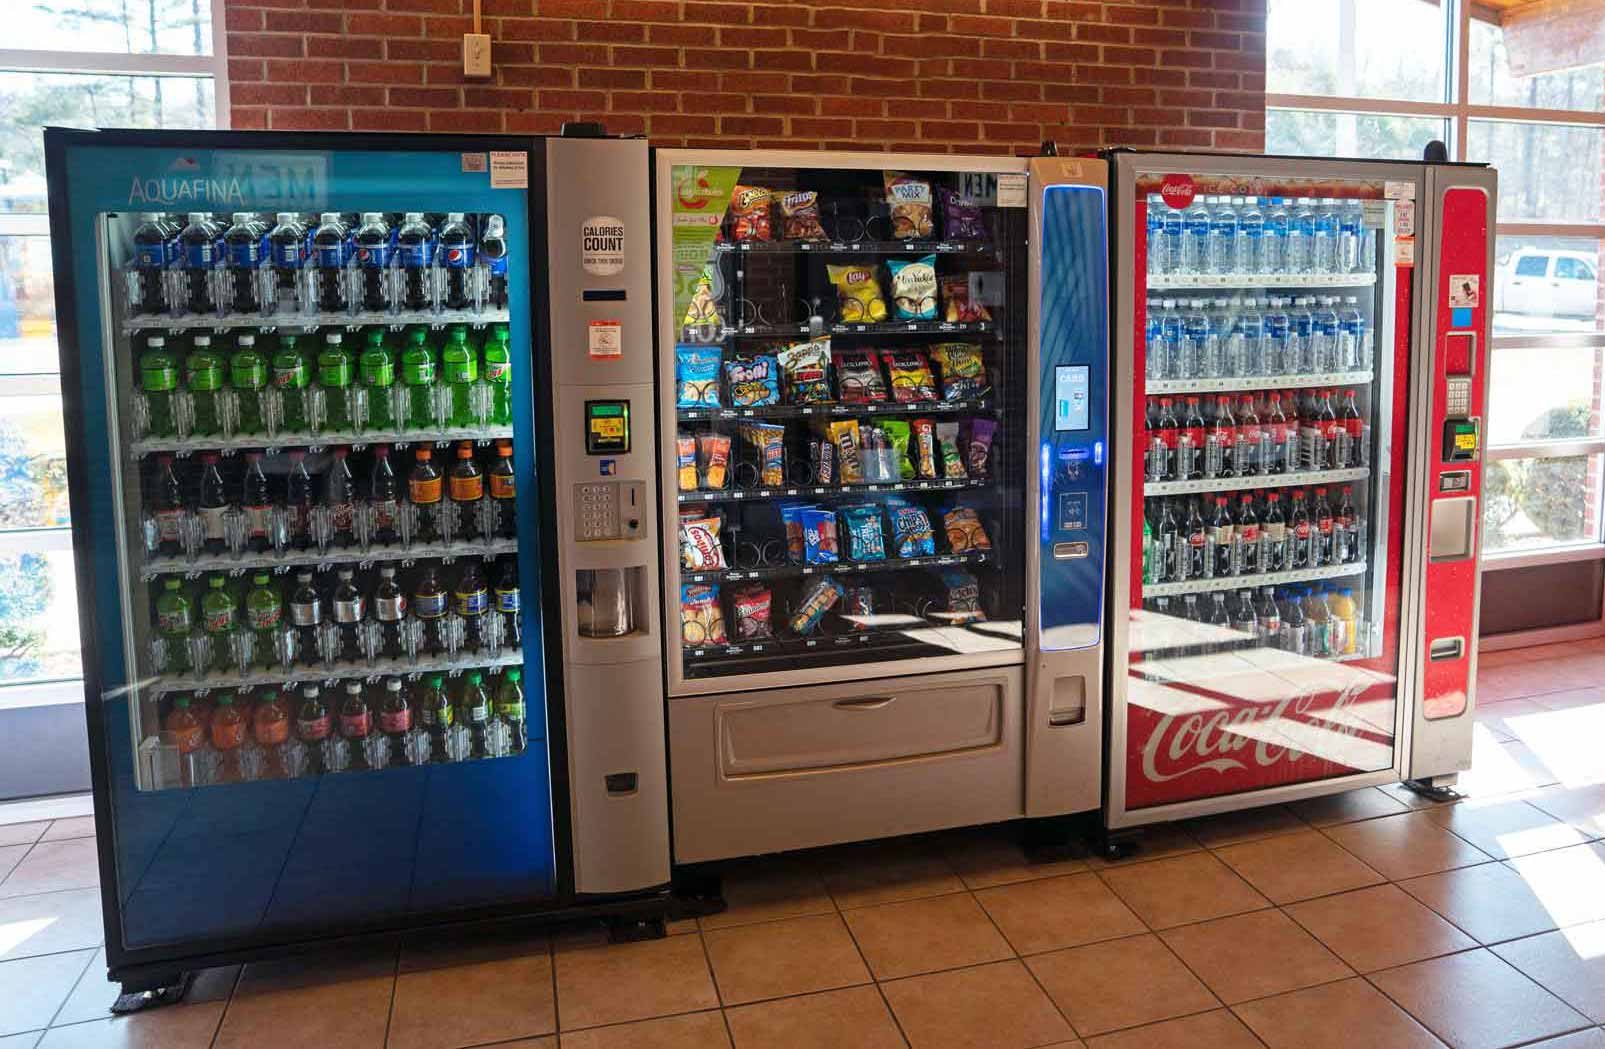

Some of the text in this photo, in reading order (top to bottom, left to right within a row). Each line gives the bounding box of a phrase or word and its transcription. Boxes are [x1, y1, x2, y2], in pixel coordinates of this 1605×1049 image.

[128, 174, 246, 206] AQUAFINA
[894, 184, 926, 194] PARTY
[583, 226, 624, 237] CALORIES
[583, 237, 624, 252] COUNT
